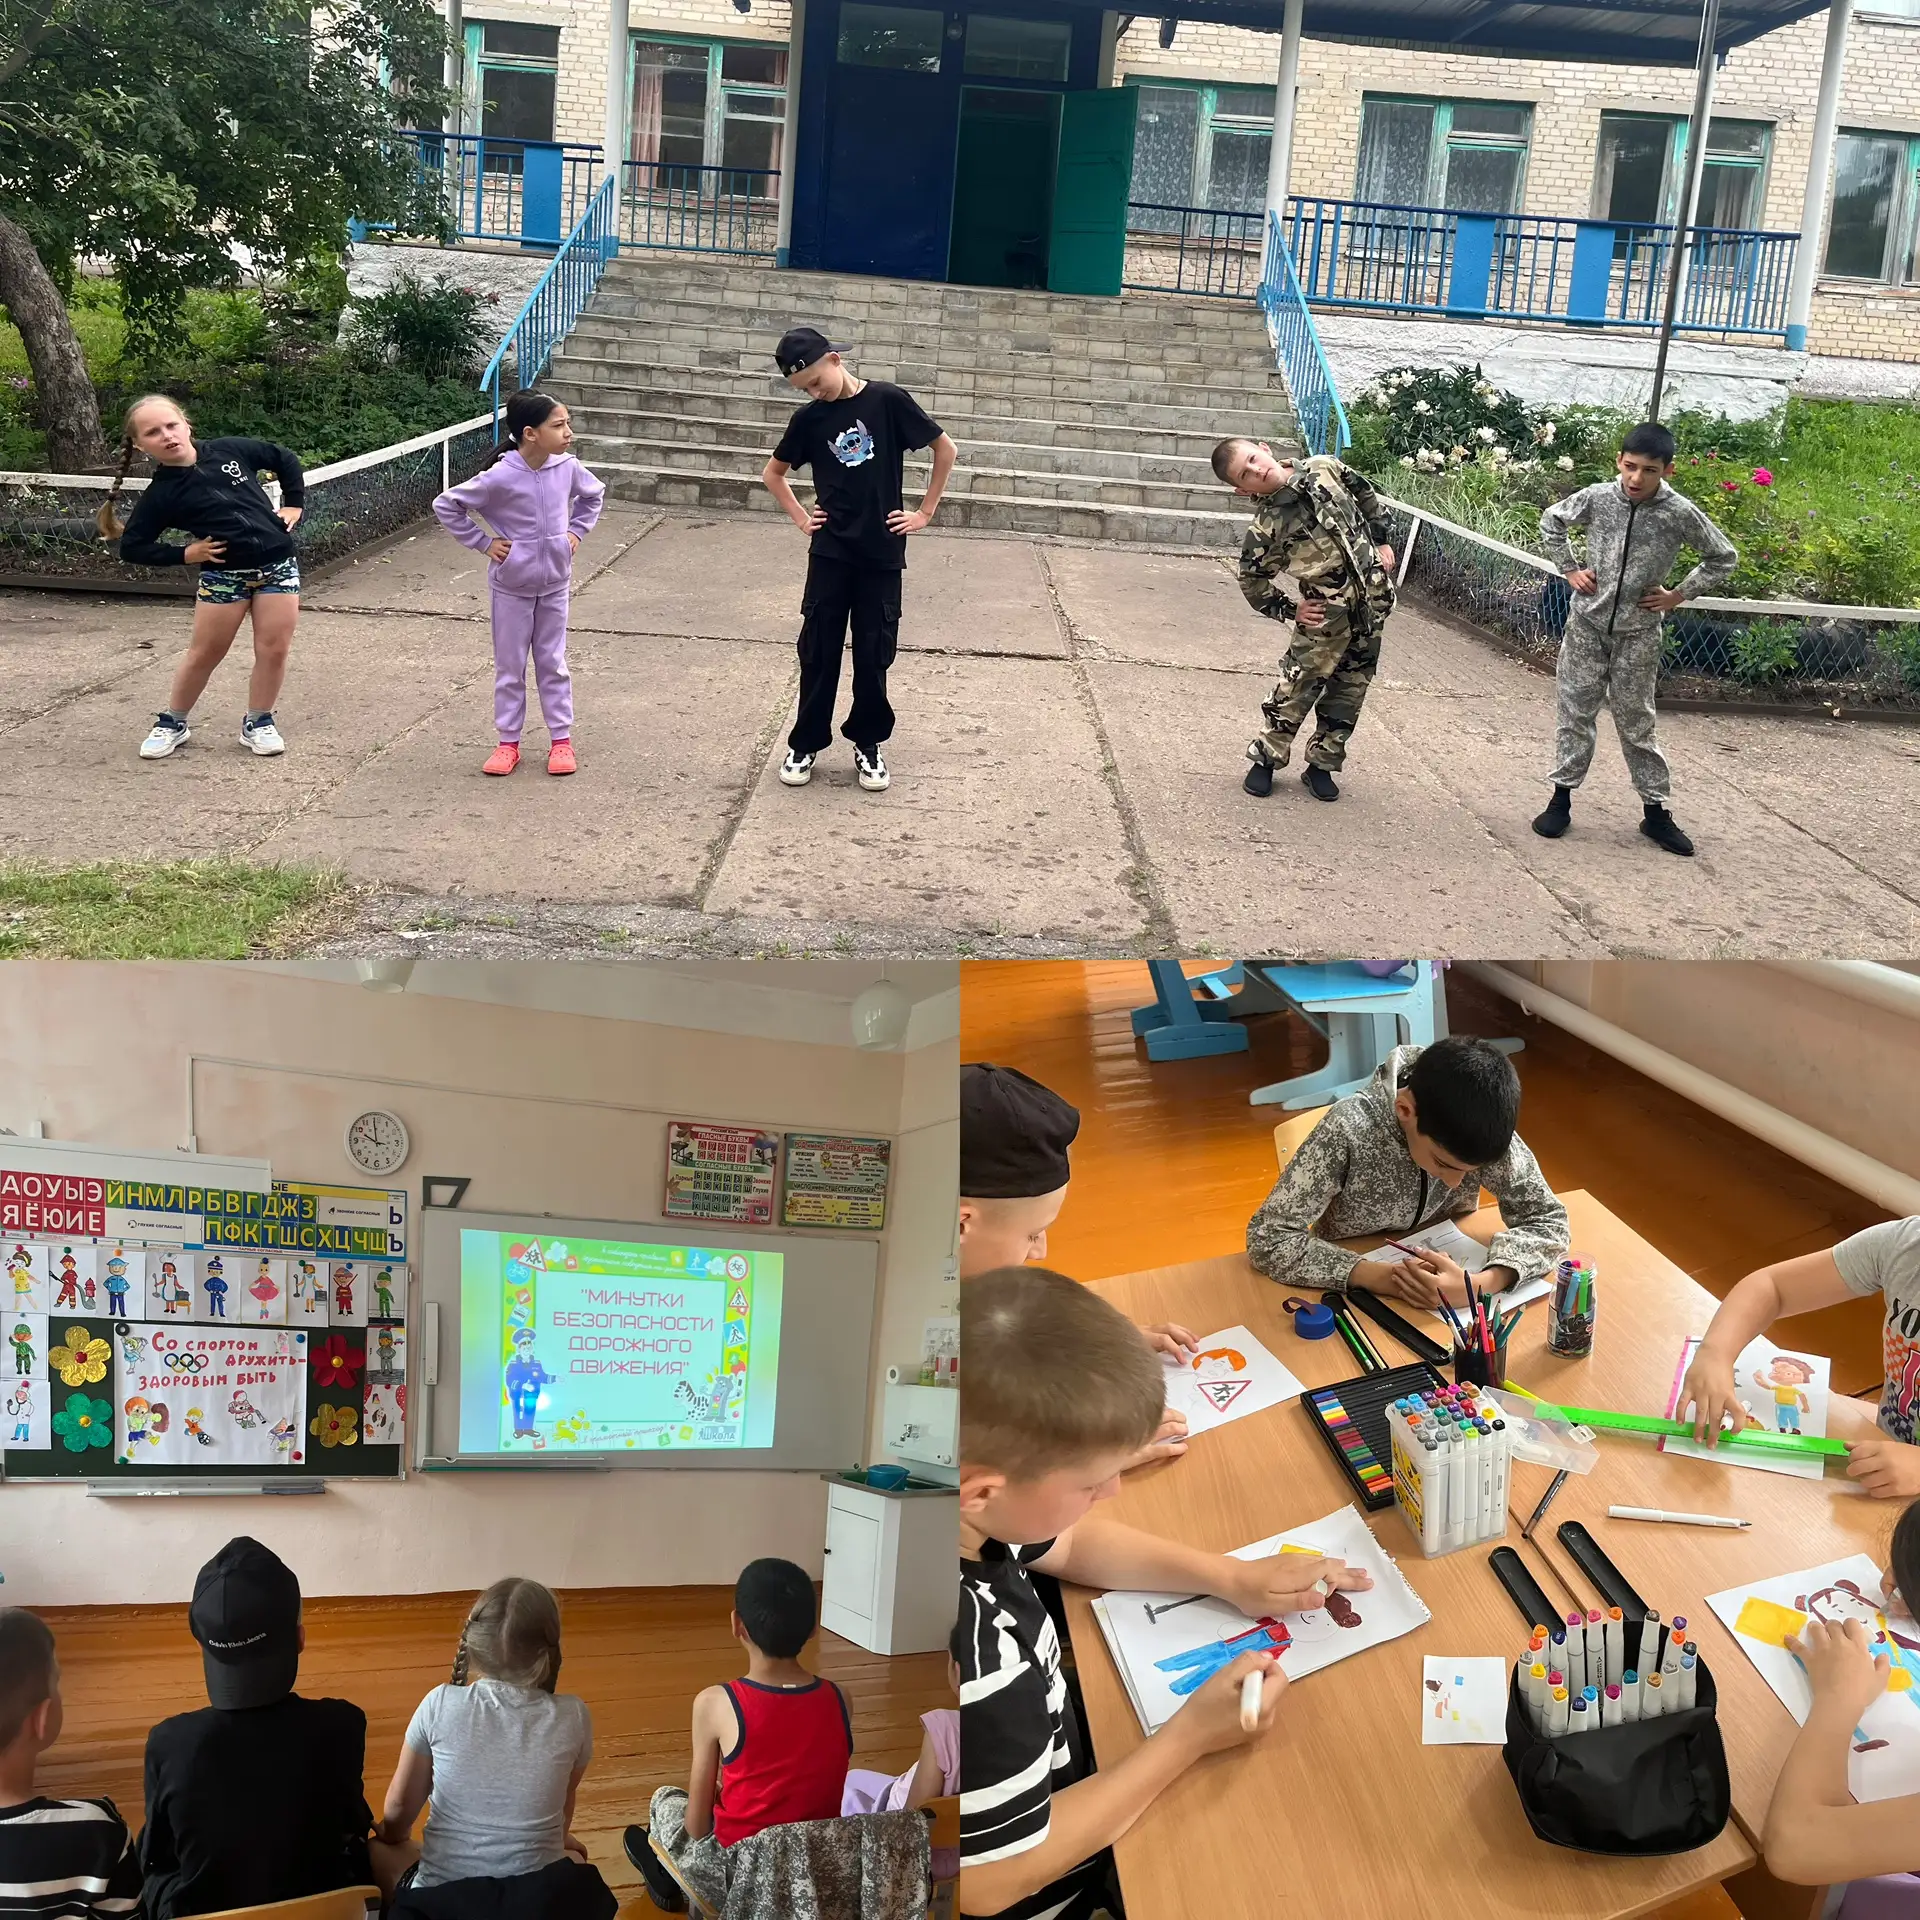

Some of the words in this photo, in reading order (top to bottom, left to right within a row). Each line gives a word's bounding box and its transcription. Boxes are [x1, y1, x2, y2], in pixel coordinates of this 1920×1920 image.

[698, 1133, 726, 1141] ГЛАСНЫЕ
[728, 1135, 749, 1143] БУКВЫ
[695, 1161, 731, 1170] СОГЛАСНЫЕ
[734, 1164, 754, 1172] БУКВЫ
[389, 1205, 403, 1225] Ь
[388, 1233, 404, 1252] Ъ
[553, 1311, 714, 1332] БЕЗОПАСНОСТИ
[568, 1336, 692, 1353] ДОРОЖНОГО
[138, 1374, 228, 1391] ЗДОРОВЫМ
[236, 1372, 277, 1386] БЫТЬ
